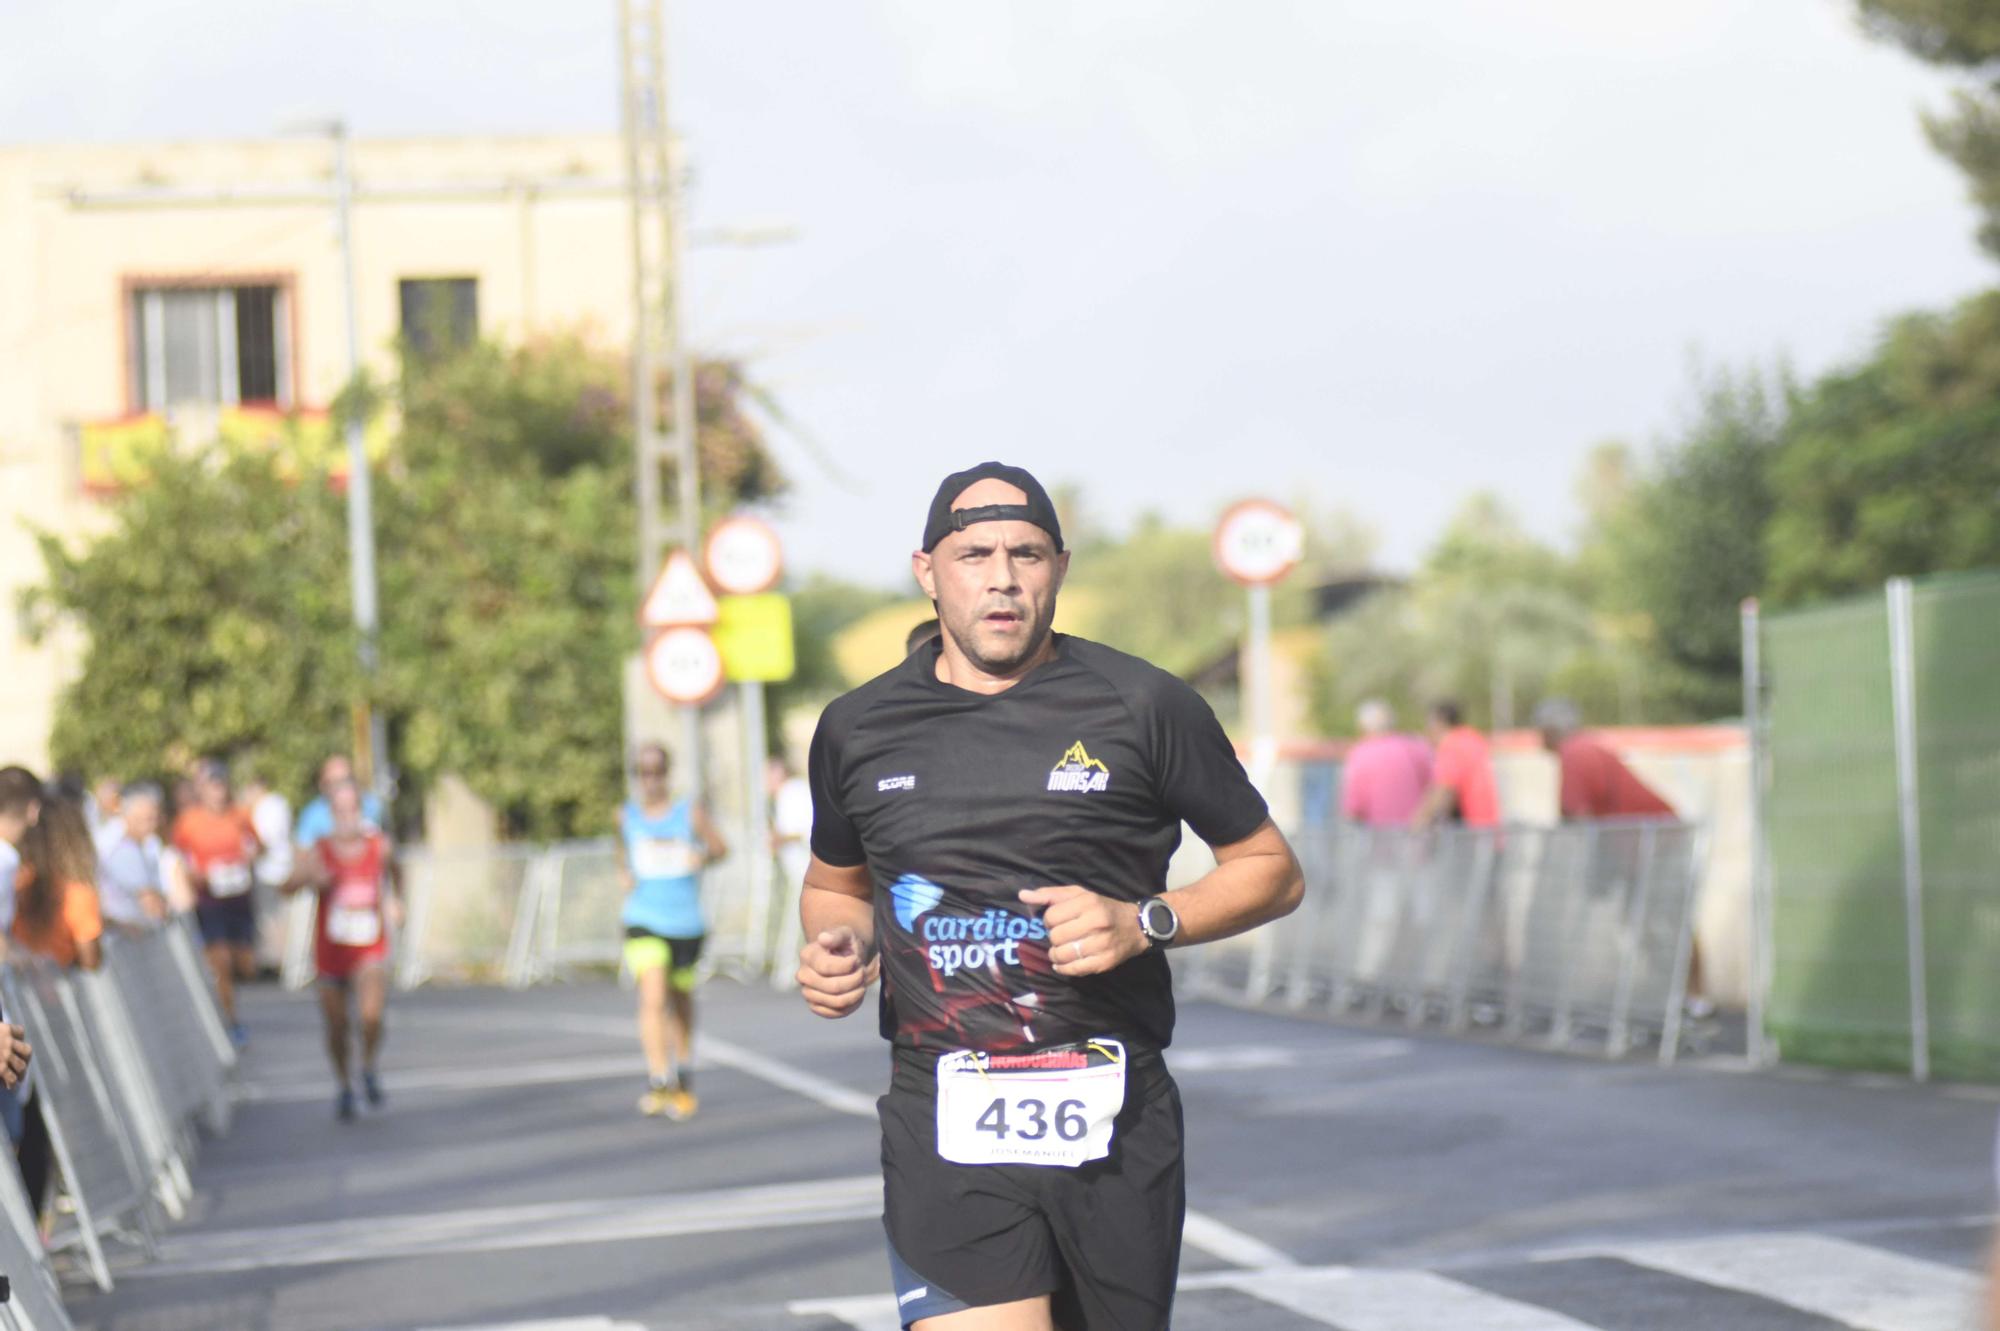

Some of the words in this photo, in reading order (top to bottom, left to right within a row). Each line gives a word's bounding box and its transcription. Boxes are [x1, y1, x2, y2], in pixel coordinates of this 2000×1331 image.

[924, 911, 1046, 941] cardios
[929, 938, 1020, 976] sport
[976, 1098, 1088, 1141] 436
